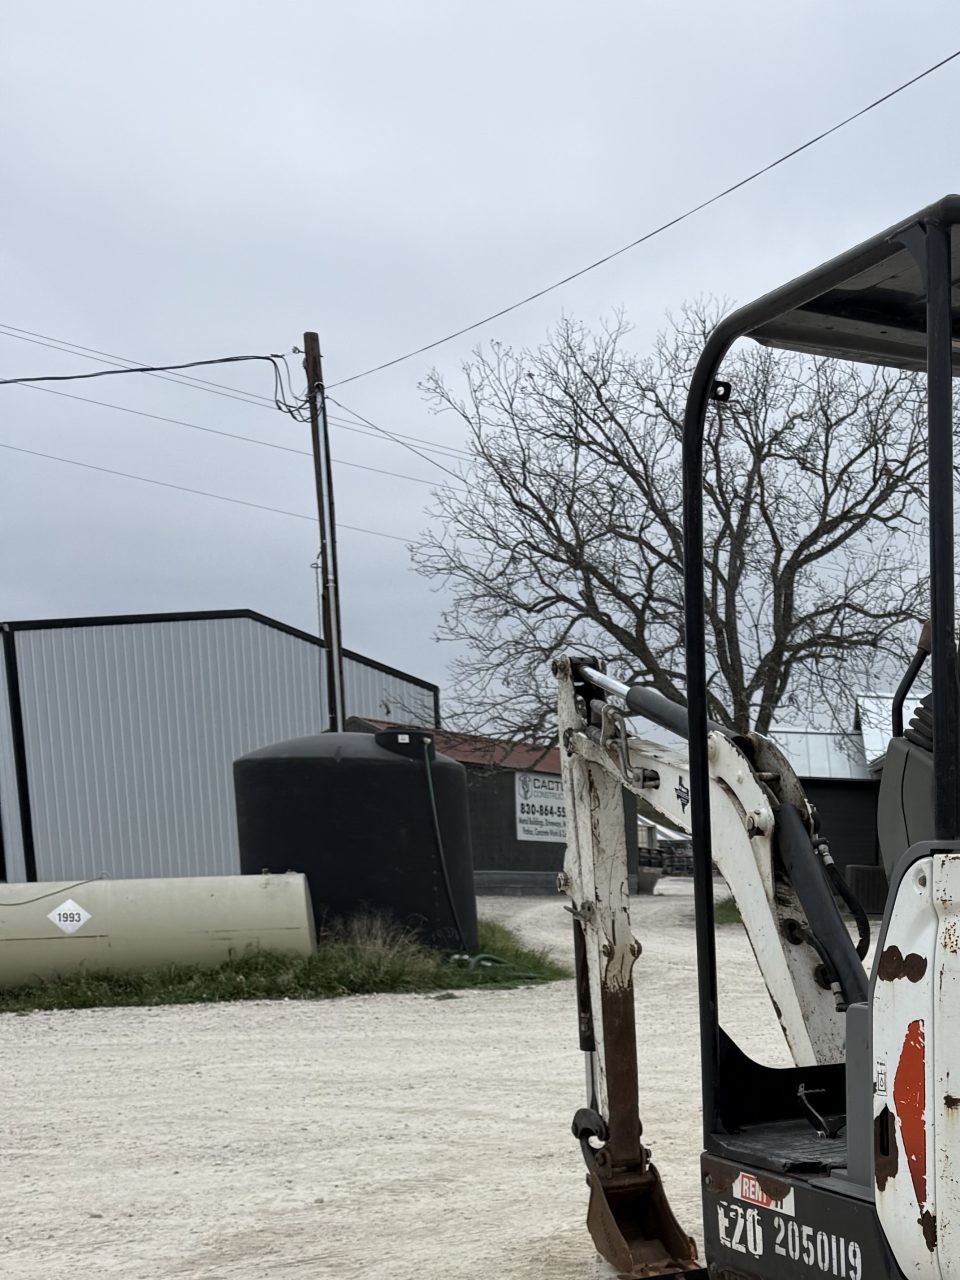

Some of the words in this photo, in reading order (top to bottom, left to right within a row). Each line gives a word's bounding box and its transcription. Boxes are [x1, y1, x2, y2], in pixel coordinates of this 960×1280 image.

[533, 791, 565, 800] CONSTRUC
[520, 802, 566, 818] 830-864-55
[57, 912, 82, 923] 1993
